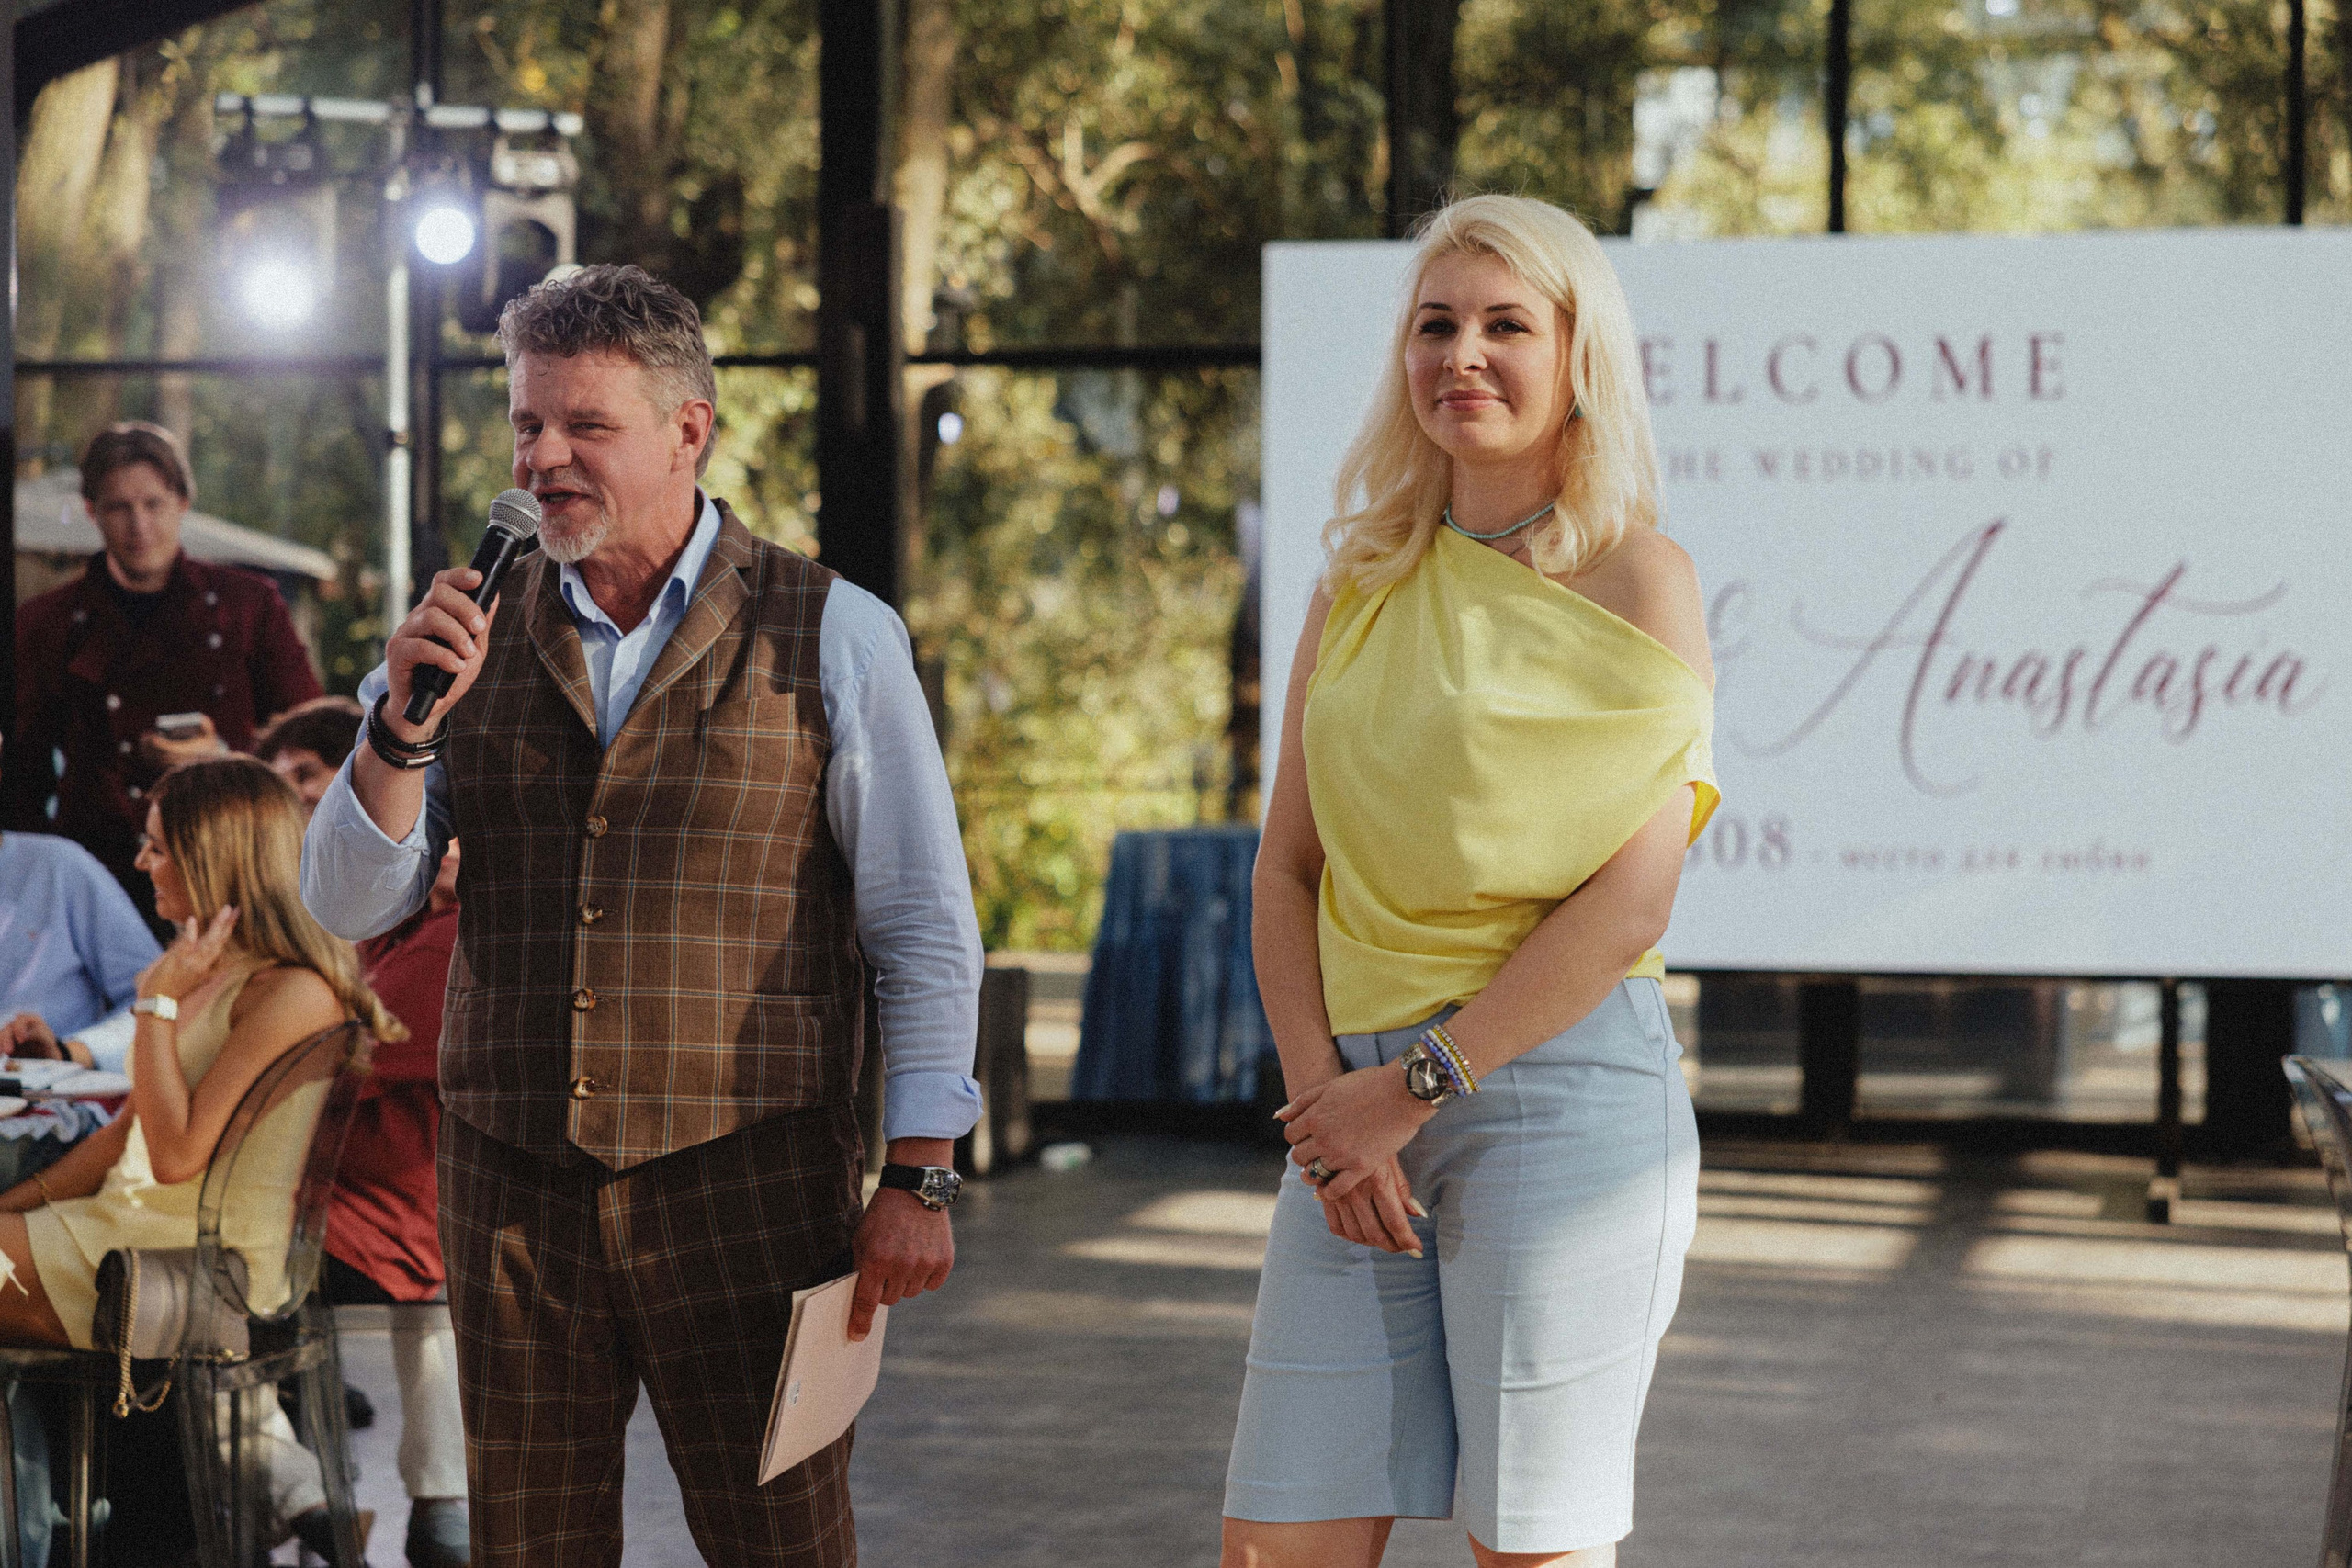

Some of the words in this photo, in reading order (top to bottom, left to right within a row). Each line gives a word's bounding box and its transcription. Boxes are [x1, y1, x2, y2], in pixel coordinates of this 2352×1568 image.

[1639, 332, 2066, 405] ELCOME
[1667, 445, 1723, 482] HE
[1751, 443, 1974, 482] WEDDING
[1996, 442, 2054, 481] OF
[1726, 514, 2335, 799] Anastasia
[1686, 808, 1792, 874] 08
